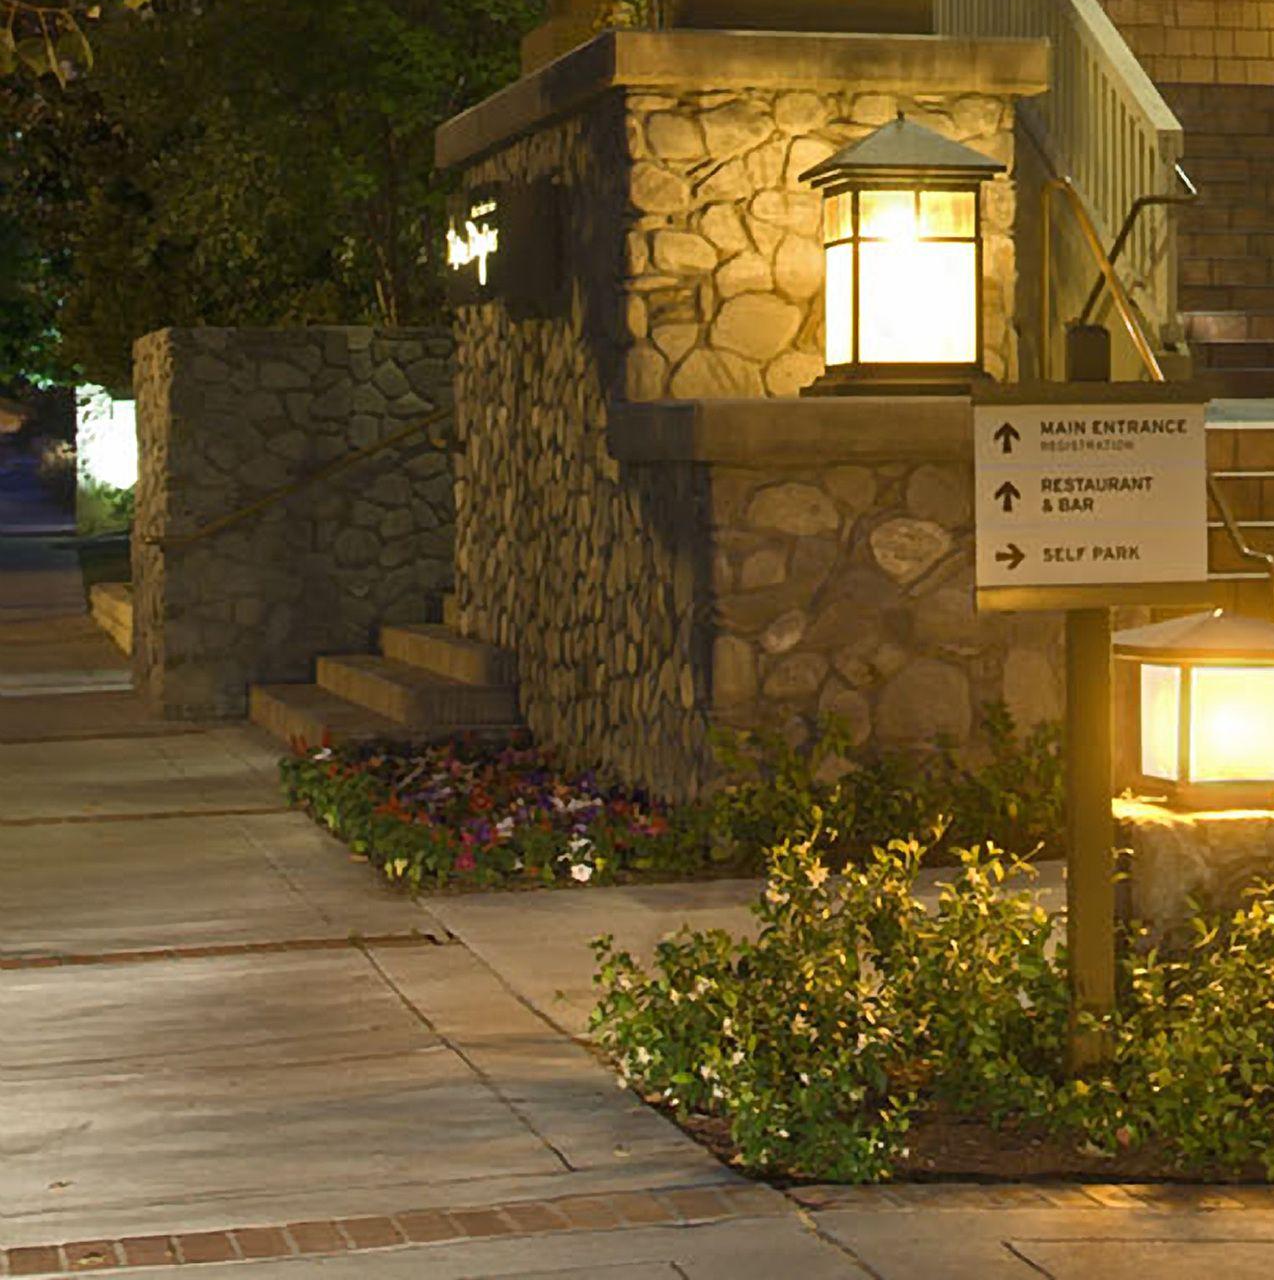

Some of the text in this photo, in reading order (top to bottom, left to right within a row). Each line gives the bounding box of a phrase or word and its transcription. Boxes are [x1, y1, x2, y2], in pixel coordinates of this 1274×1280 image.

[1040, 418, 1188, 435] MAIN ENTRANCE
[1041, 476, 1154, 492] RESTAURANT
[1042, 496, 1094, 512] & BAR
[1043, 545, 1140, 562] SELF PARK
